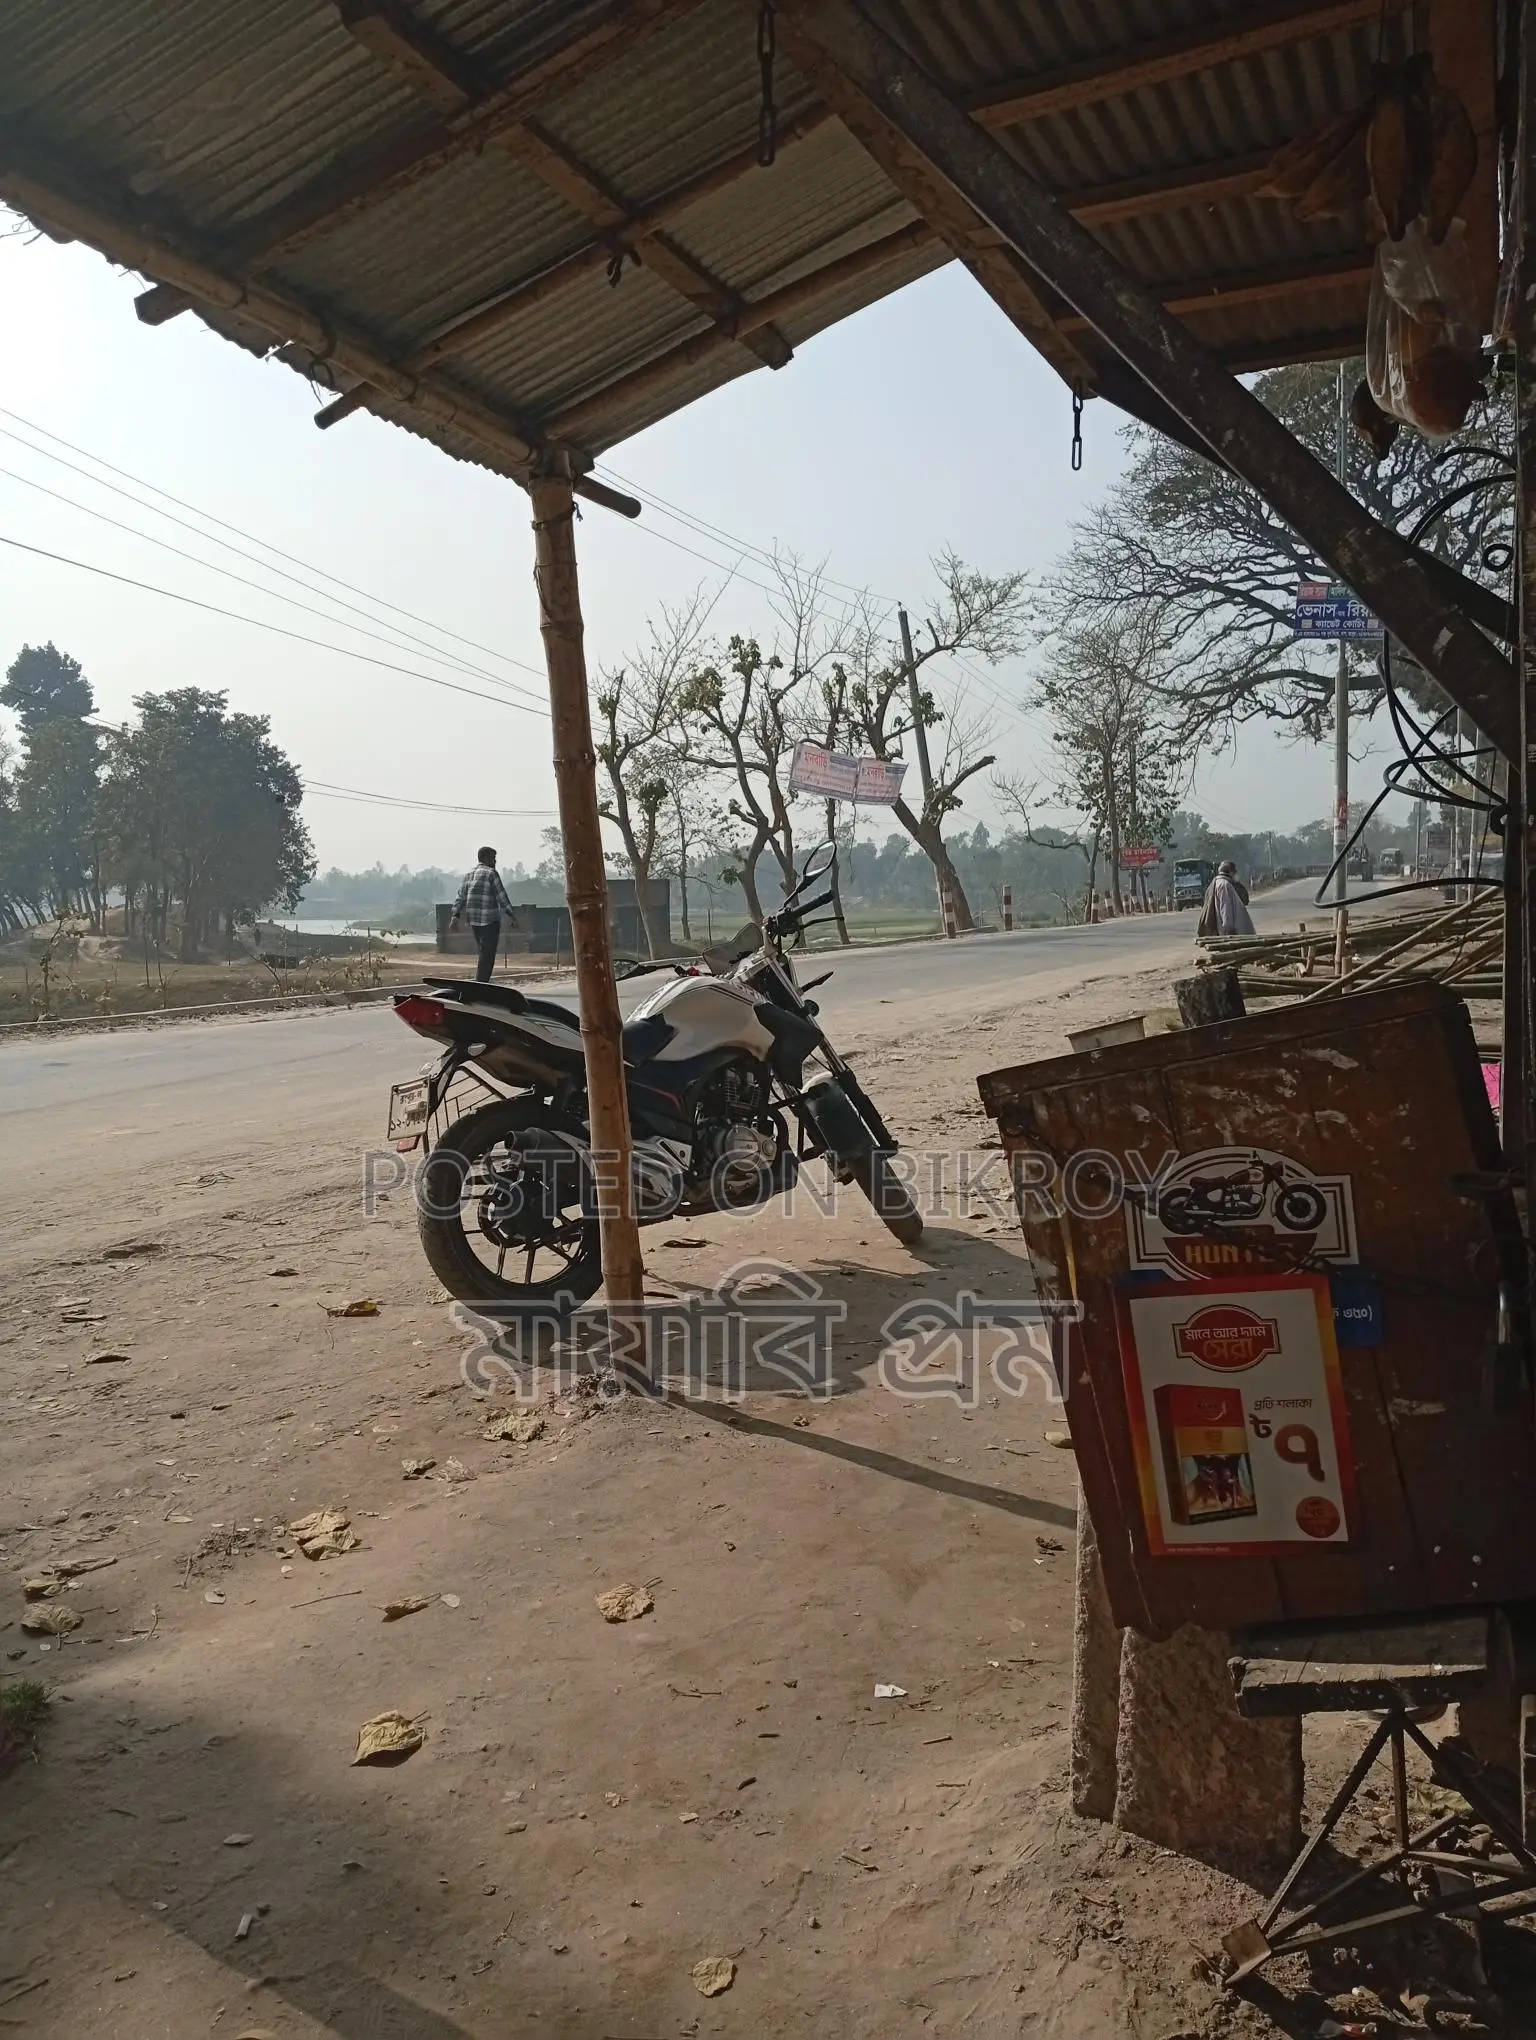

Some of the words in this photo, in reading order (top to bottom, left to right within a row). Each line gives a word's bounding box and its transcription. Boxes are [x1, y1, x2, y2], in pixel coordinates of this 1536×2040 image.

[1185, 1328, 1210, 1340] মানে
[1211, 1327, 1238, 1338] আর
[1240, 1326, 1266, 1337] দামে
[1202, 1338, 1254, 1359] সেরা
[1254, 1397, 1274, 1410] প্রতি
[1276, 1398, 1314, 1409] শলাকা
